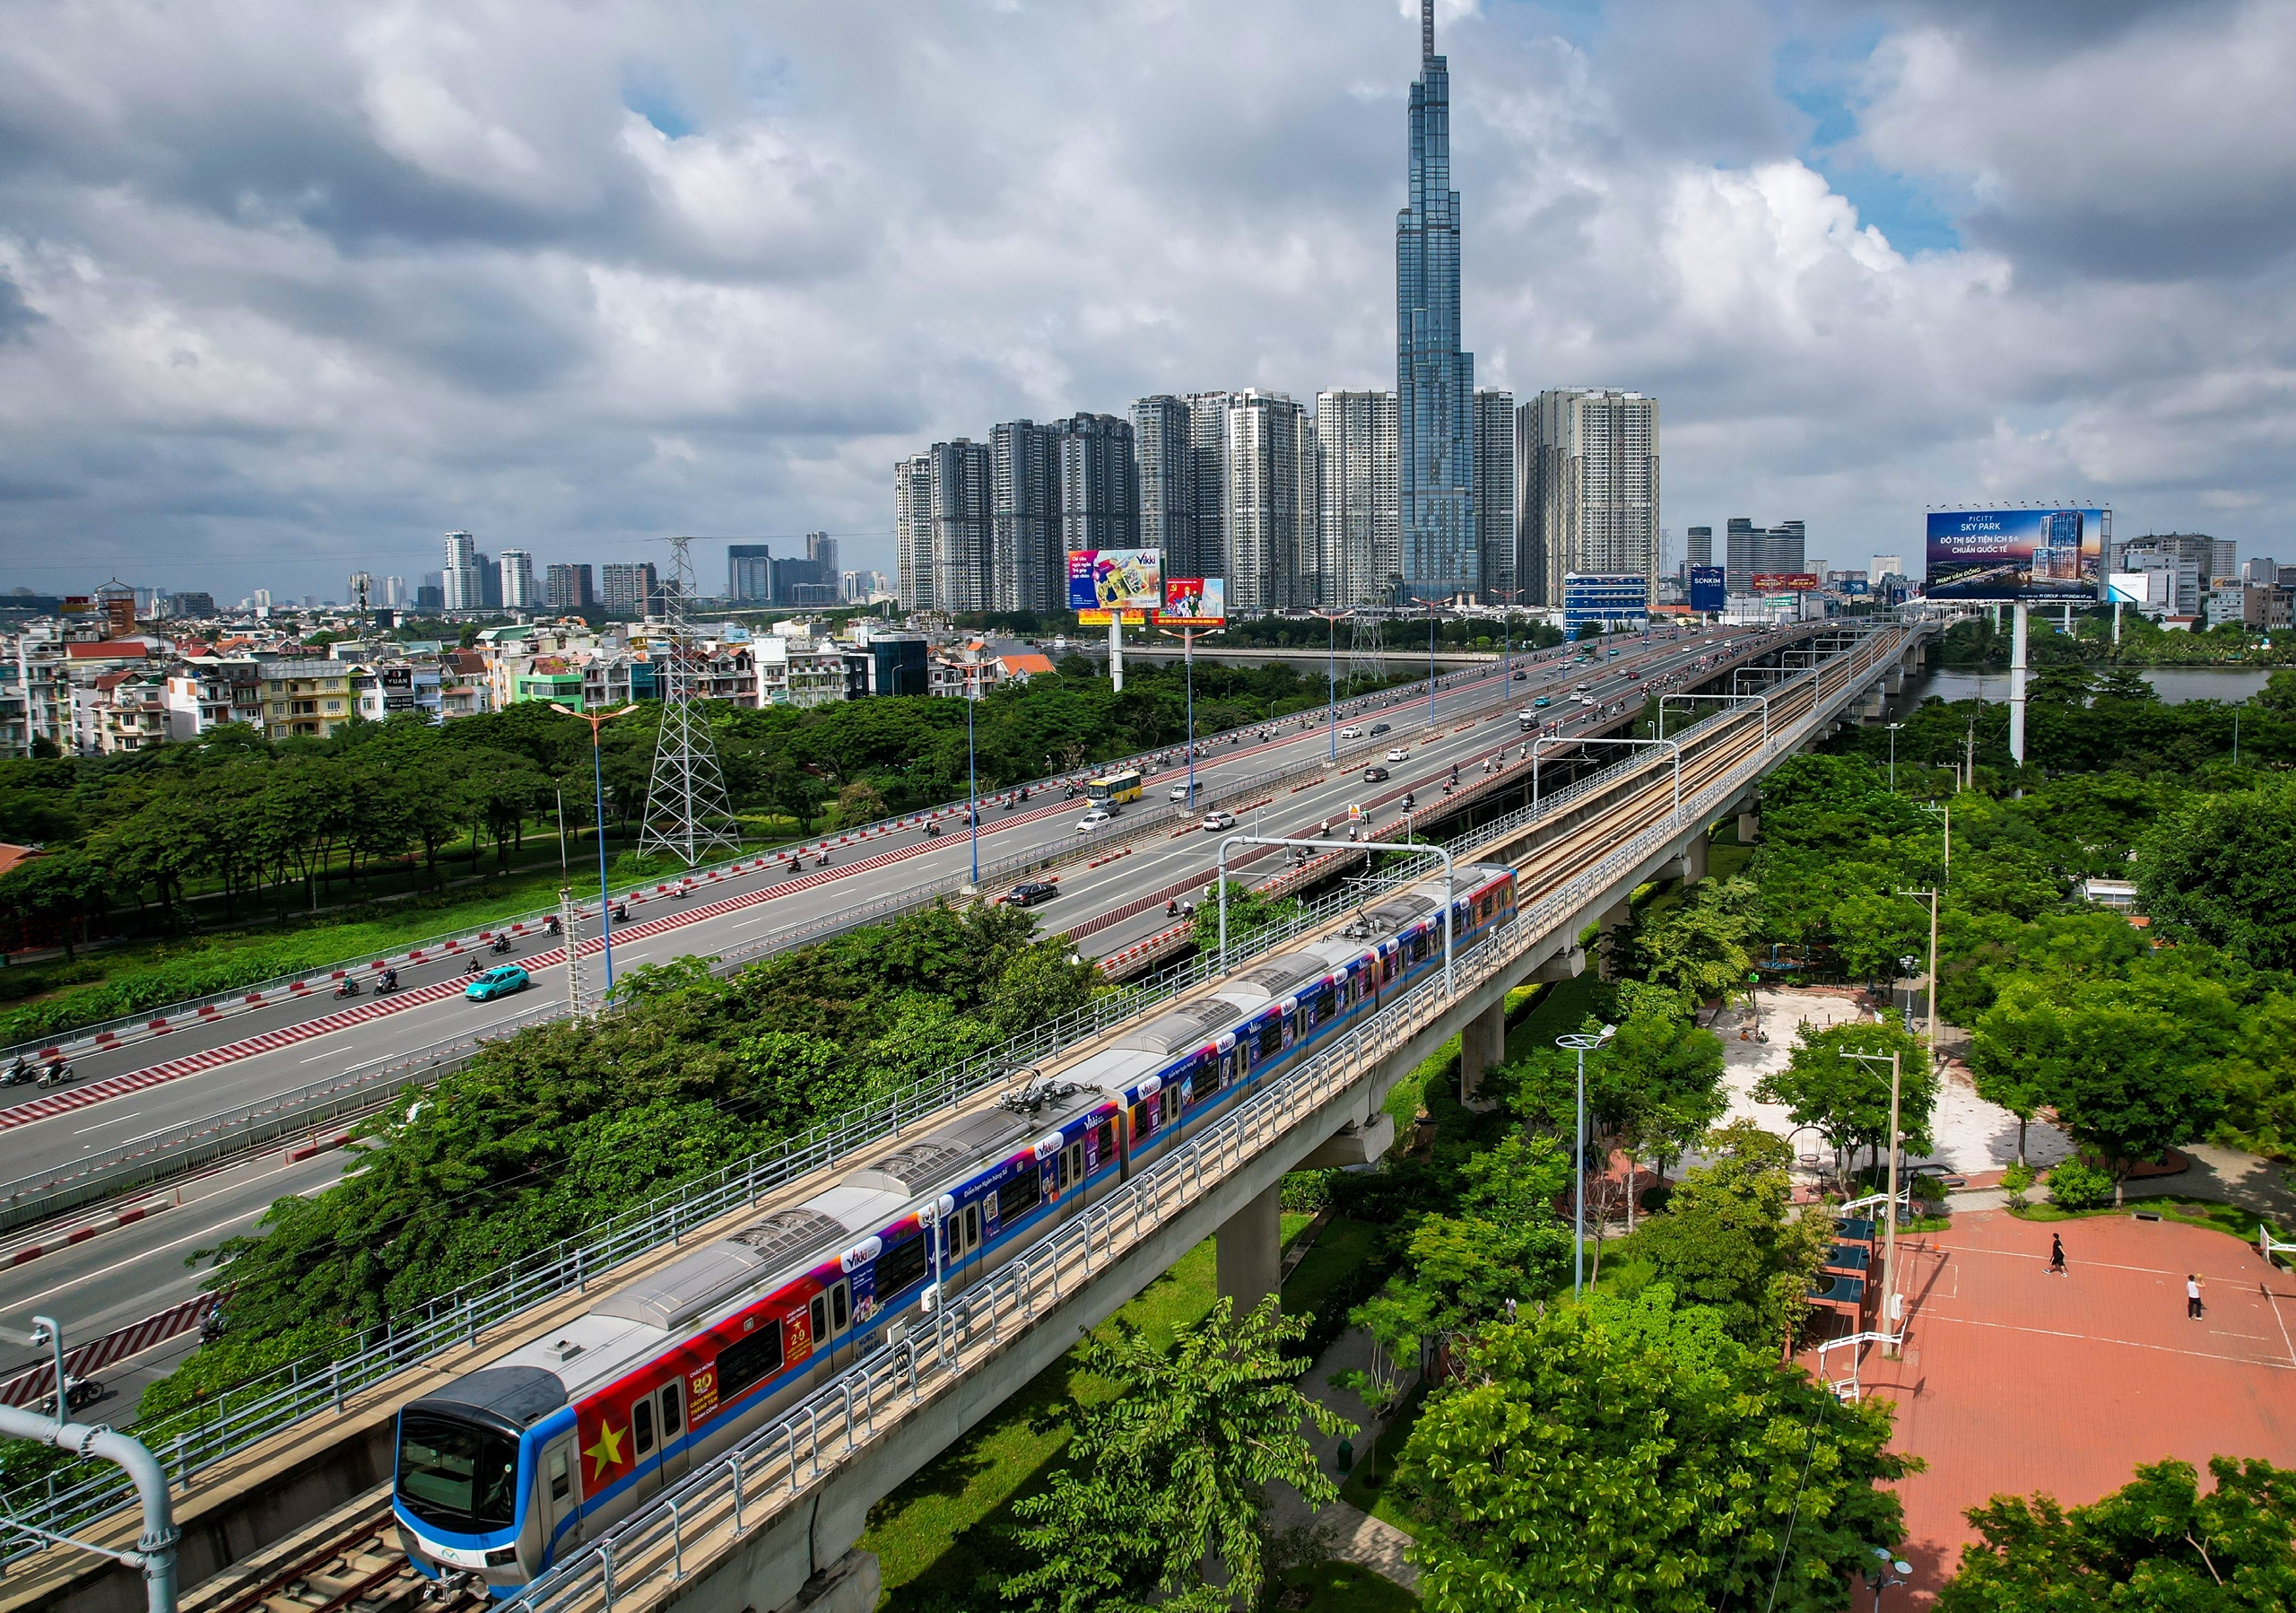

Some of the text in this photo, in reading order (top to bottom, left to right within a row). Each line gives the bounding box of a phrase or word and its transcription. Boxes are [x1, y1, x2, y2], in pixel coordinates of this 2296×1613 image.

[1961, 522, 2001, 531] SKY PARK
[1940, 536, 1952, 545] ĐÔ
[1952, 536, 1964, 545] THỊ
[1965, 535, 1977, 544] SỐ
[1978, 535, 1993, 545] TIỆN
[1994, 535, 2007, 543] ÍCH
[1952, 544, 2008, 554] CHUẨN QUỐC TẾ
[1136, 552, 1156, 565] Vikki
[1083, 1114, 1098, 1130] Vikki
[1039, 1140, 1054, 1156] Vikki
[847, 1248, 867, 1269] Vikki
[858, 1330, 876, 1347] HURC1
[689, 1360, 715, 1379] CHÀO MỪNG
[692, 1373, 712, 1394] 80
[690, 1397, 703, 1408] CÁCH
[690, 1396, 718, 1416] THÁNG TÁM
[691, 1403, 718, 1423] THÀNH CÔNG
